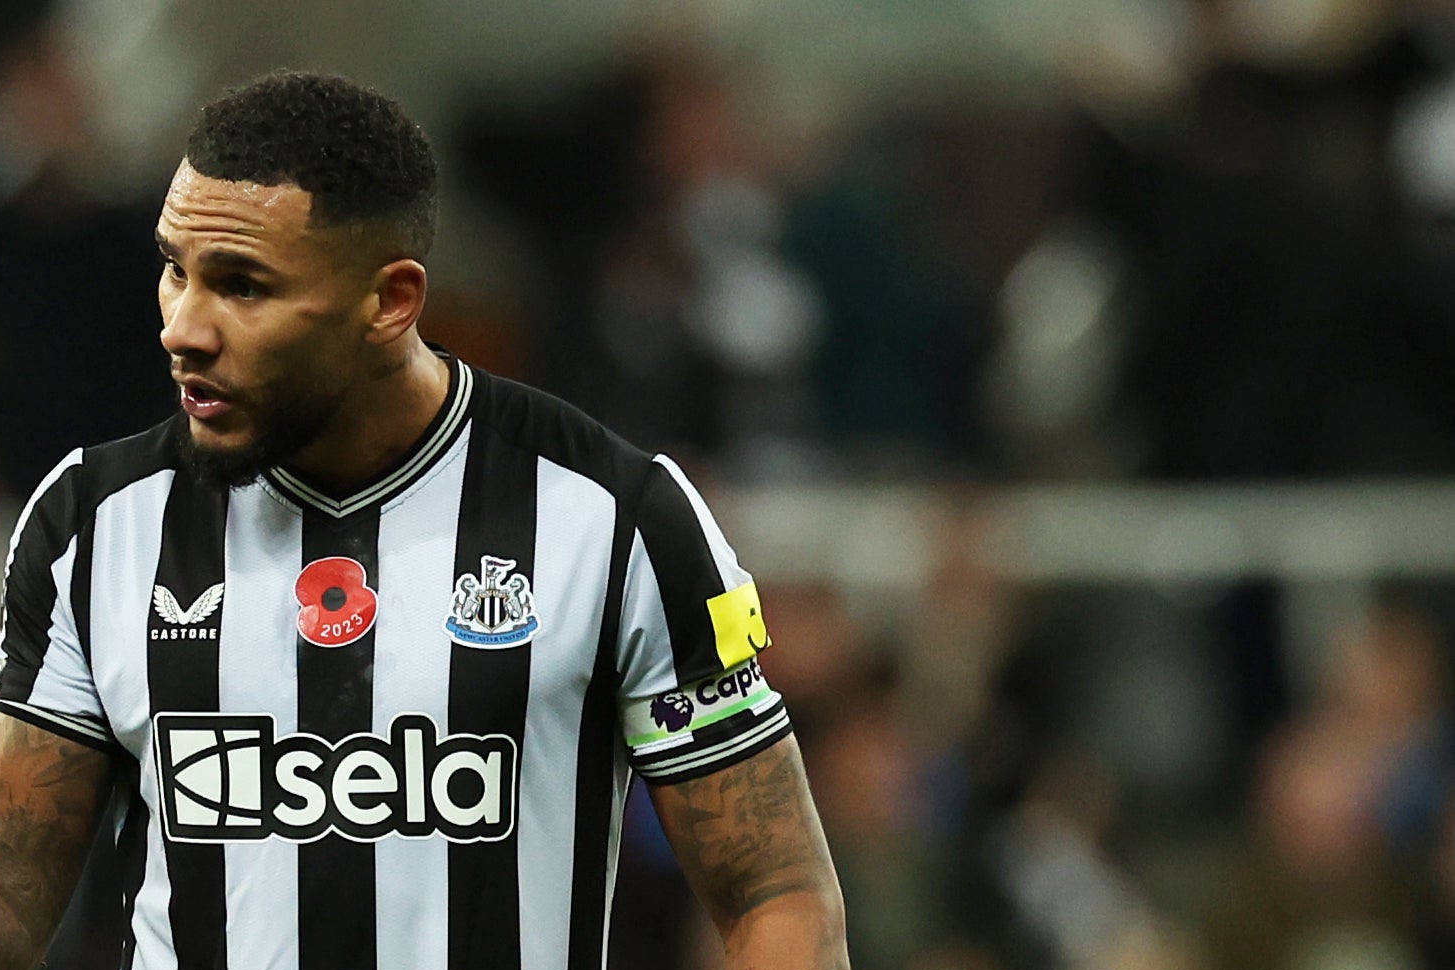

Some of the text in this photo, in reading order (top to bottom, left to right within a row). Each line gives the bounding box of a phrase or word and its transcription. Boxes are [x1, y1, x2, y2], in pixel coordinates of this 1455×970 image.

[151, 628, 217, 640] CASTORE
[320, 613, 363, 637] 2023
[696, 656, 763, 706] Capt
[272, 728, 502, 826] sela
